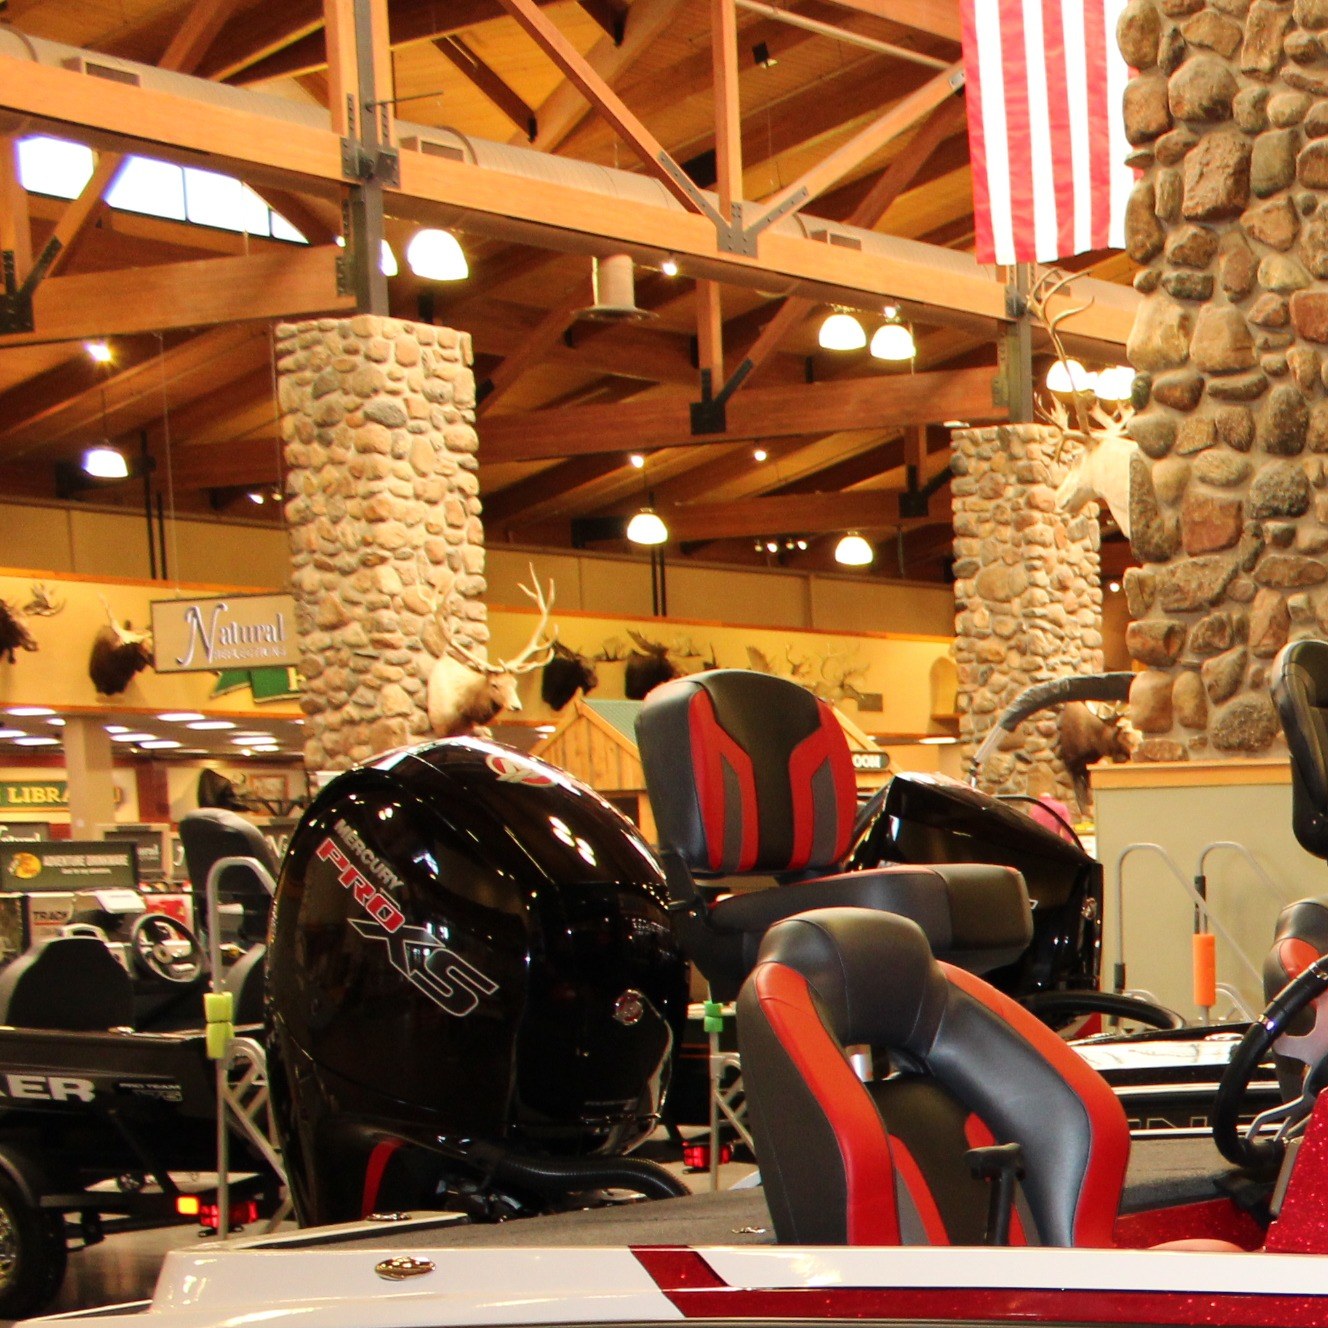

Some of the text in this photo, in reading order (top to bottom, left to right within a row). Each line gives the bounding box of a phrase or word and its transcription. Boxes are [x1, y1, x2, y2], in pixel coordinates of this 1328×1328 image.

[176, 603, 286, 666] Natural
[316, 837, 406, 933] PRO
[334, 818, 405, 889] MERCURY
[347, 918, 500, 1017] XS
[0, 1073, 96, 1102] ER
